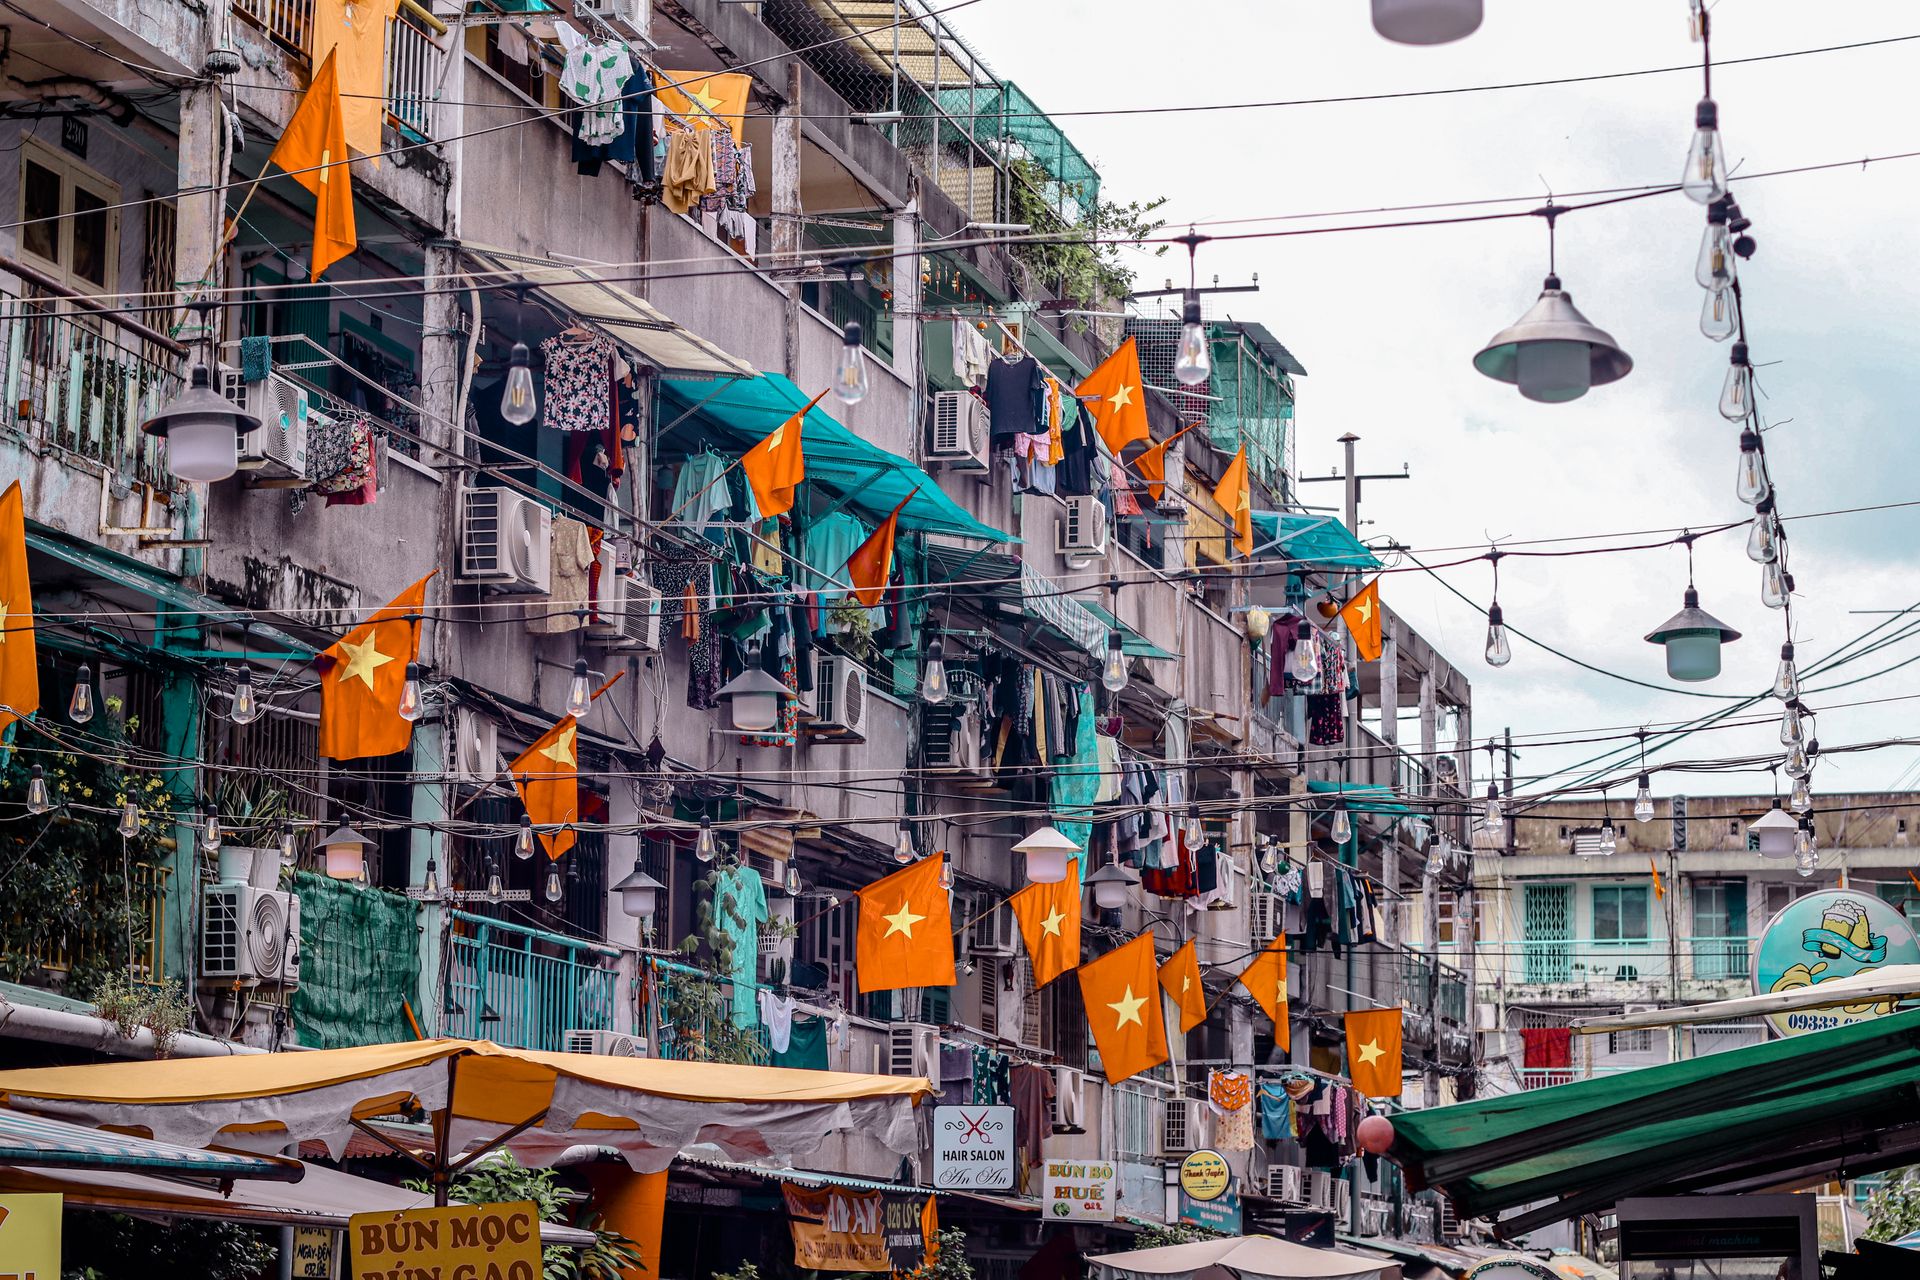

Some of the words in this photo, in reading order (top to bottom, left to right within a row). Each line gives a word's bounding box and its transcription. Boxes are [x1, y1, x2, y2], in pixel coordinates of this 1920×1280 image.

[65, 119, 85, 146] 230
[943, 1150, 967, 1161] HAIR
[970, 1150, 1005, 1161] SALON
[939, 1165, 972, 1185] An
[975, 1165, 1008, 1185] An
[1048, 1160, 1086, 1179] BÚN
[1089, 1162, 1113, 1180] BÒ
[1184, 1169, 1203, 1178] Thanh
[1054, 1182, 1105, 1201] HUẾ
[852, 1197, 878, 1234] AN
[887, 1202, 901, 1229] 026
[359, 1213, 439, 1256] BÚN
[449, 1213, 530, 1253] MỌC
